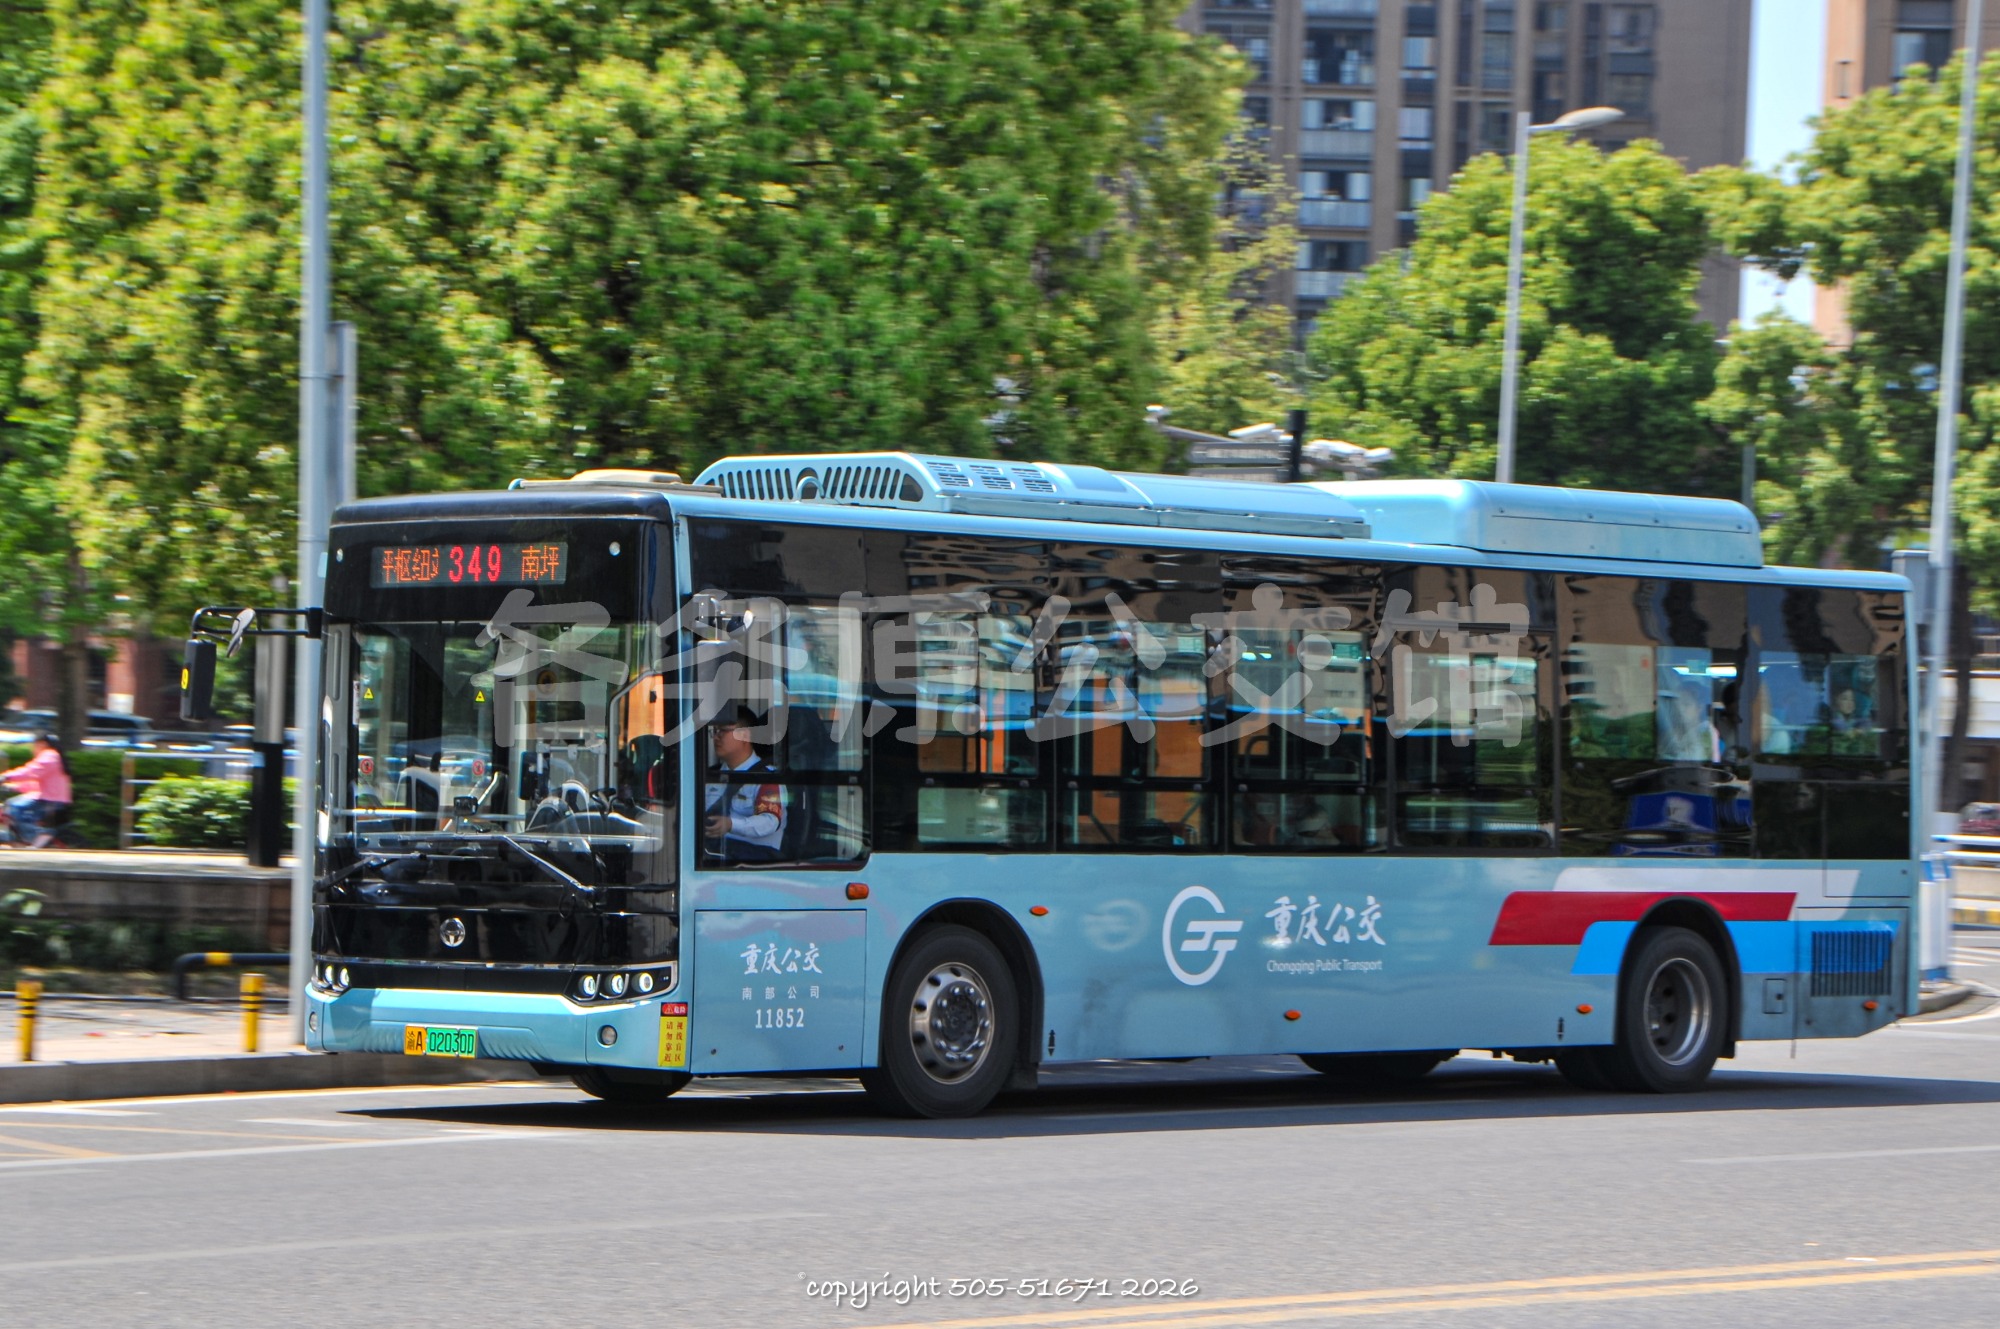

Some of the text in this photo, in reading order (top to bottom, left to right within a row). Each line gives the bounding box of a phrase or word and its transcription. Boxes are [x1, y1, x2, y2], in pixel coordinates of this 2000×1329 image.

[449, 546, 502, 583] 349
[521, 546, 560, 581] 南坪
[1264, 895, 1386, 946] 重庆公交
[740, 943, 823, 975] 重庆公交
[1267, 959, 1382, 974] Chongqing Public Transport
[742, 986, 819, 1000] 南部公司
[755, 1007, 804, 1029] 11852
